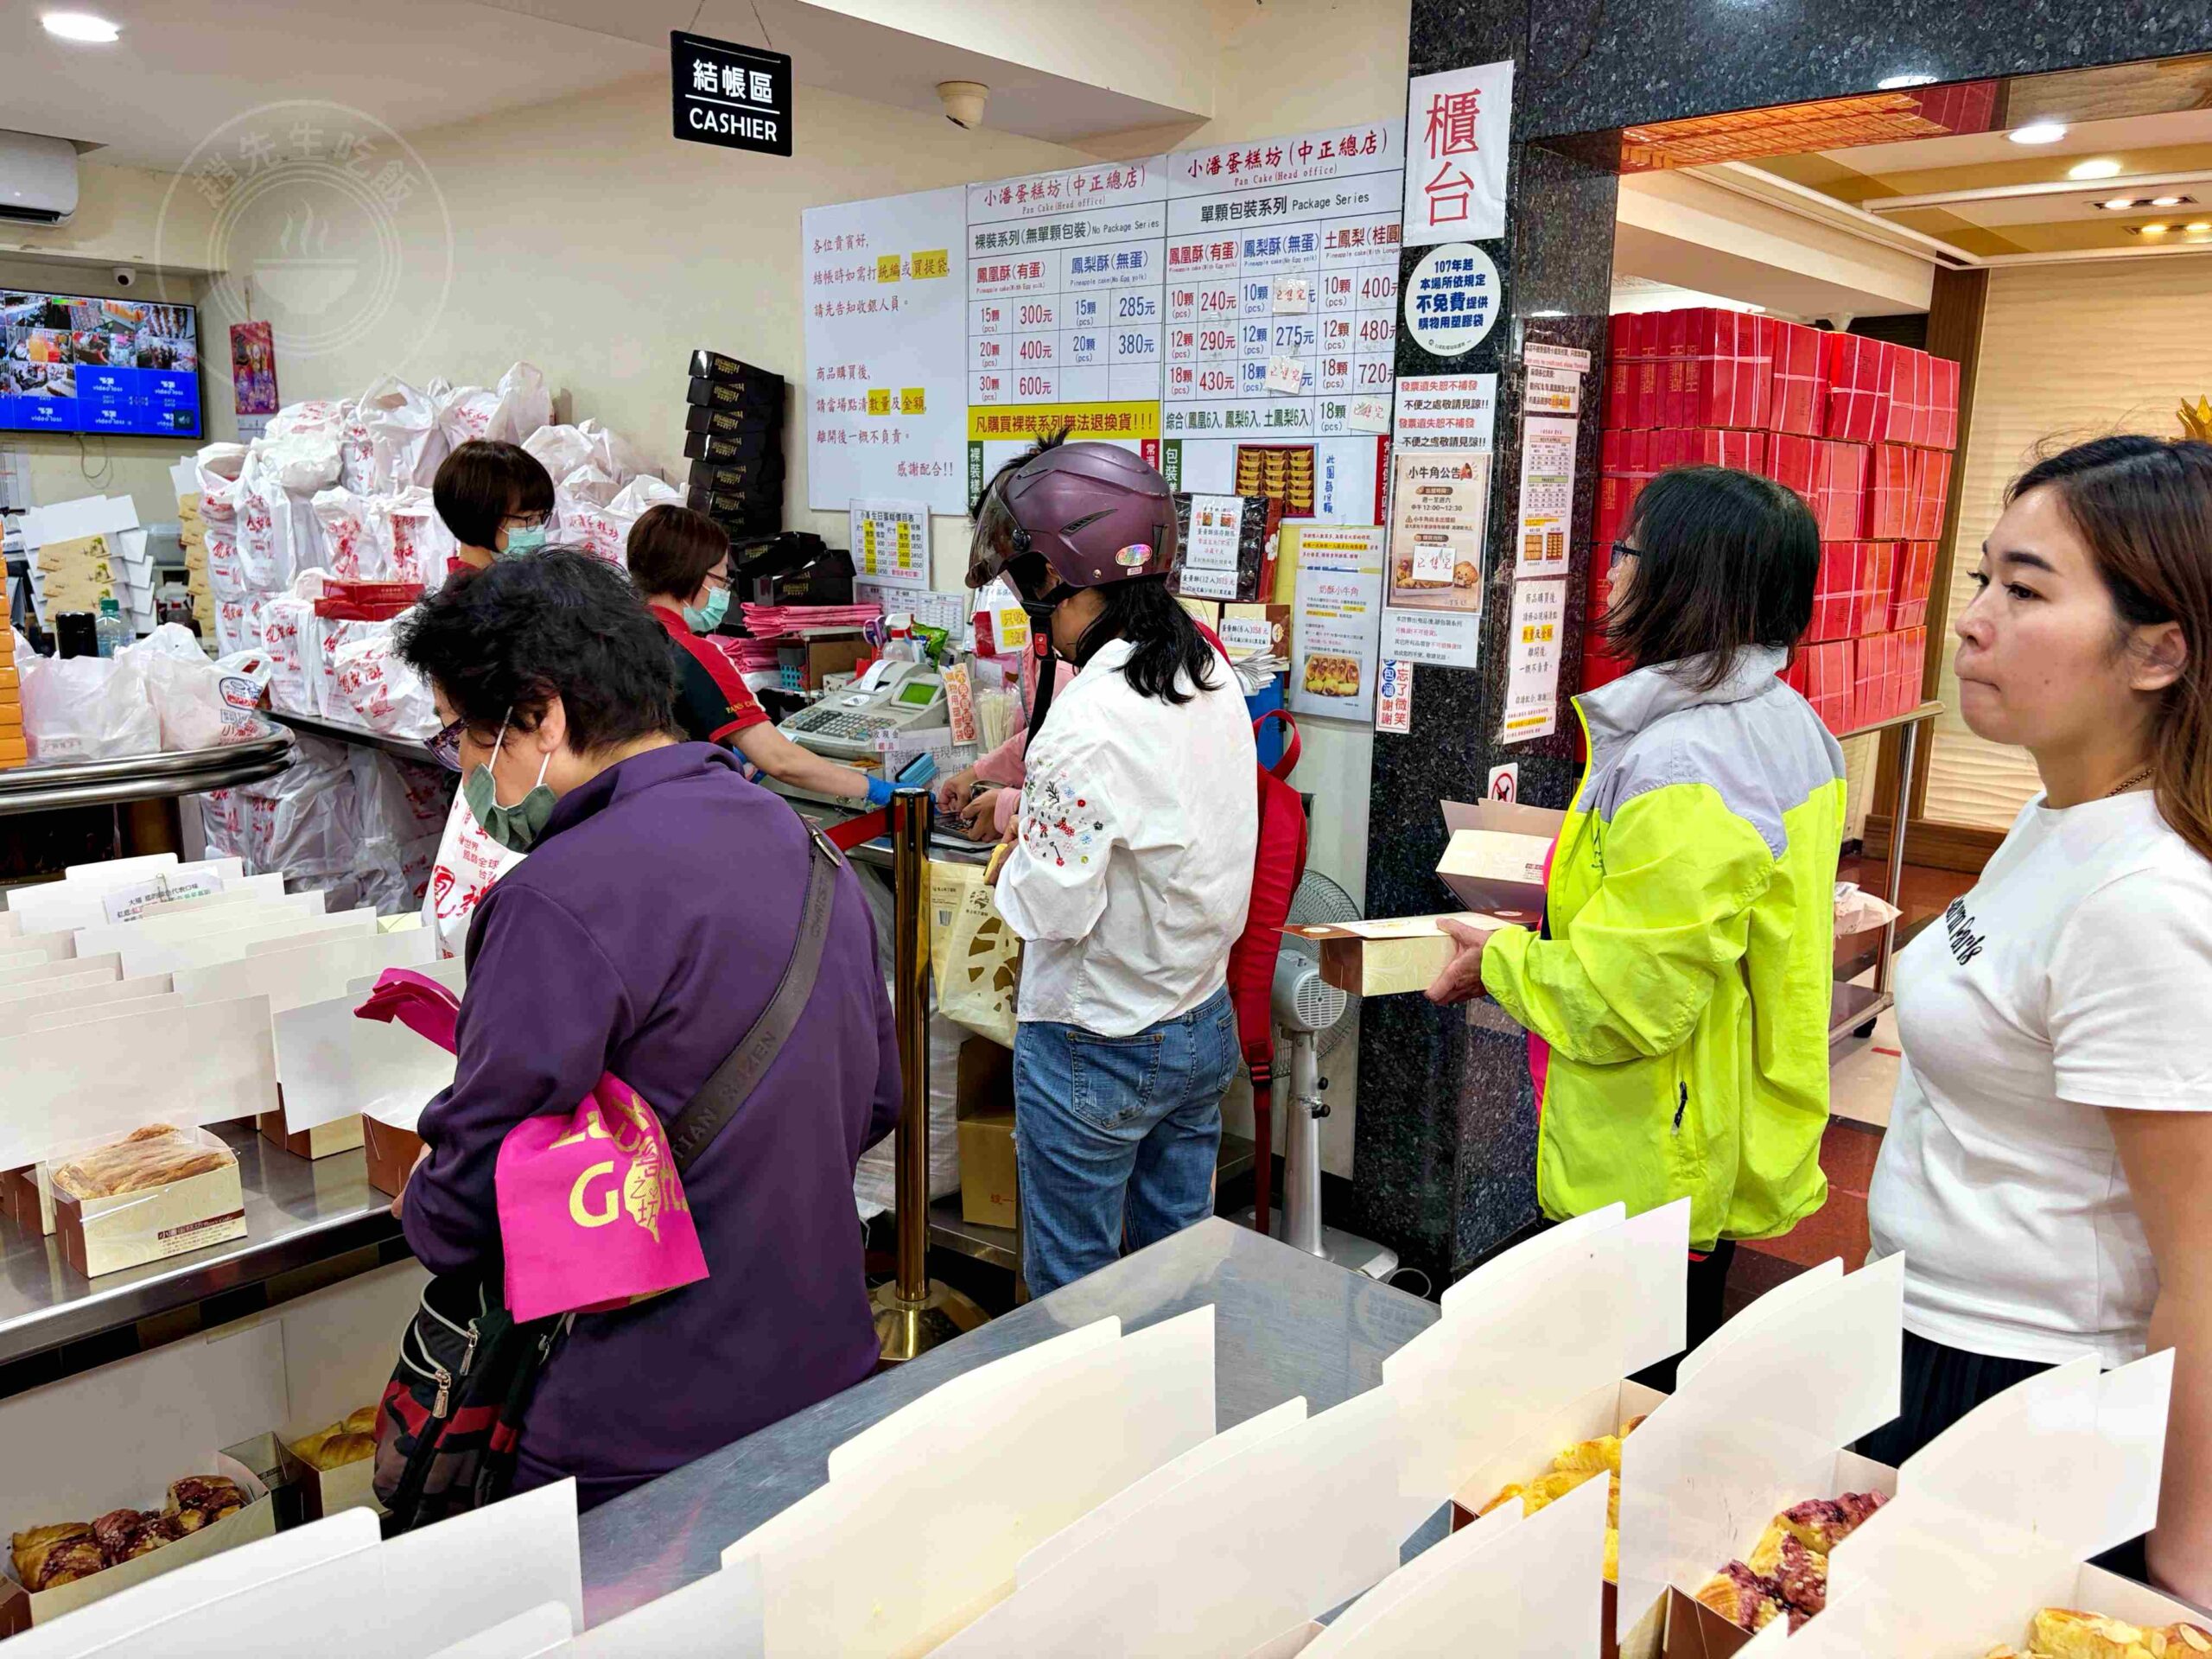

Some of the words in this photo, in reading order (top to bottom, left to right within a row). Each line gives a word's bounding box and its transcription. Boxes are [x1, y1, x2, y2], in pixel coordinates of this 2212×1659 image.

[693, 59, 772, 104] 結帳區
[689, 107, 777, 142] CASHIER
[1187, 128, 1388, 178] 小潘蛋糕坊(中正總店)
[1424, 88, 1482, 226] 櫃台
[984, 164, 1146, 207] 小潘蛋糕坊(中正總店)
[1234, 177, 1249, 187] Pan
[1022, 204, 1034, 214] Pan
[1201, 196, 1287, 223] 單顆包裝系列
[1293, 198, 1331, 211] Package
[1336, 193, 1370, 205] Series
[1103, 221, 1132, 233] Package
[1135, 219, 1160, 230] Series
[1169, 241, 1239, 265] 鳳凰酥(有蛋)
[1244, 233, 1319, 257] 鳳梨酥(無蛋)
[1071, 250, 1147, 275] 鳳梨酥(無蛋)
[1434, 258, 1473, 274] 107年起
[976, 262, 1046, 283] 鳳凰酥(有蛋)
[1325, 276, 1351, 296] 10顆
[1420, 274, 1486, 291] 本場所依規定
[1171, 289, 1194, 308] 10顆
[1243, 283, 1268, 301] 10顆
[1076, 299, 1096, 315] 15顆
[1119, 296, 1155, 317] 285元
[1201, 290, 1236, 312] 240元
[1244, 302, 1264, 313] (pcs)
[1325, 296, 1346, 307] (pcs)
[1416, 292, 1489, 314] 不免費提供
[982, 308, 1000, 322] 15顆
[1020, 305, 1052, 324] 300元
[1173, 308, 1191, 319] (pcs)
[982, 323, 997, 333] (pcs)
[1077, 317, 1093, 327] (pcs)
[1324, 320, 1350, 338] 12顆
[1418, 315, 1484, 331] 購物用塑膠袋
[1171, 330, 1193, 347] 12顆
[1200, 330, 1236, 351] 290元
[1243, 326, 1268, 343] 12顆
[1276, 326, 1314, 346] 275元
[980, 342, 1000, 357] 20顆
[1020, 340, 1052, 359] 400元
[1073, 336, 1096, 352] 20顆
[1119, 334, 1154, 354] 380元
[1243, 345, 1263, 354] (pcs)
[1324, 340, 1345, 350] (pcs)
[1076, 353, 1092, 362] (pcs)
[1172, 349, 1190, 359] (pcs)
[982, 359, 997, 367] (pcs)
[1243, 363, 1266, 379] 18顆
[1322, 359, 1348, 377] 18顆
[1170, 367, 1192, 383] 18顆
[1199, 368, 1235, 391] 430元
[1323, 378, 1344, 388] (pcs)
[980, 376, 1000, 391] 30顆
[1020, 377, 1052, 396] 600元
[1172, 385, 1189, 395] (pcs)
[1243, 381, 1263, 391] (pcs)
[1402, 380, 1478, 391] 發票遺失恕不補發
[982, 393, 997, 402] (pcs)
[1404, 399, 1489, 410] 不便之處敬請見諒!!
[1320, 402, 1346, 419] 18顆
[1321, 421, 1343, 431] (pcs)
[1399, 418, 1475, 429] 發票遺失恕不補發
[897, 461, 953, 477] 感謝配合!!
[1409, 467, 1461, 480] 小牛角公告
